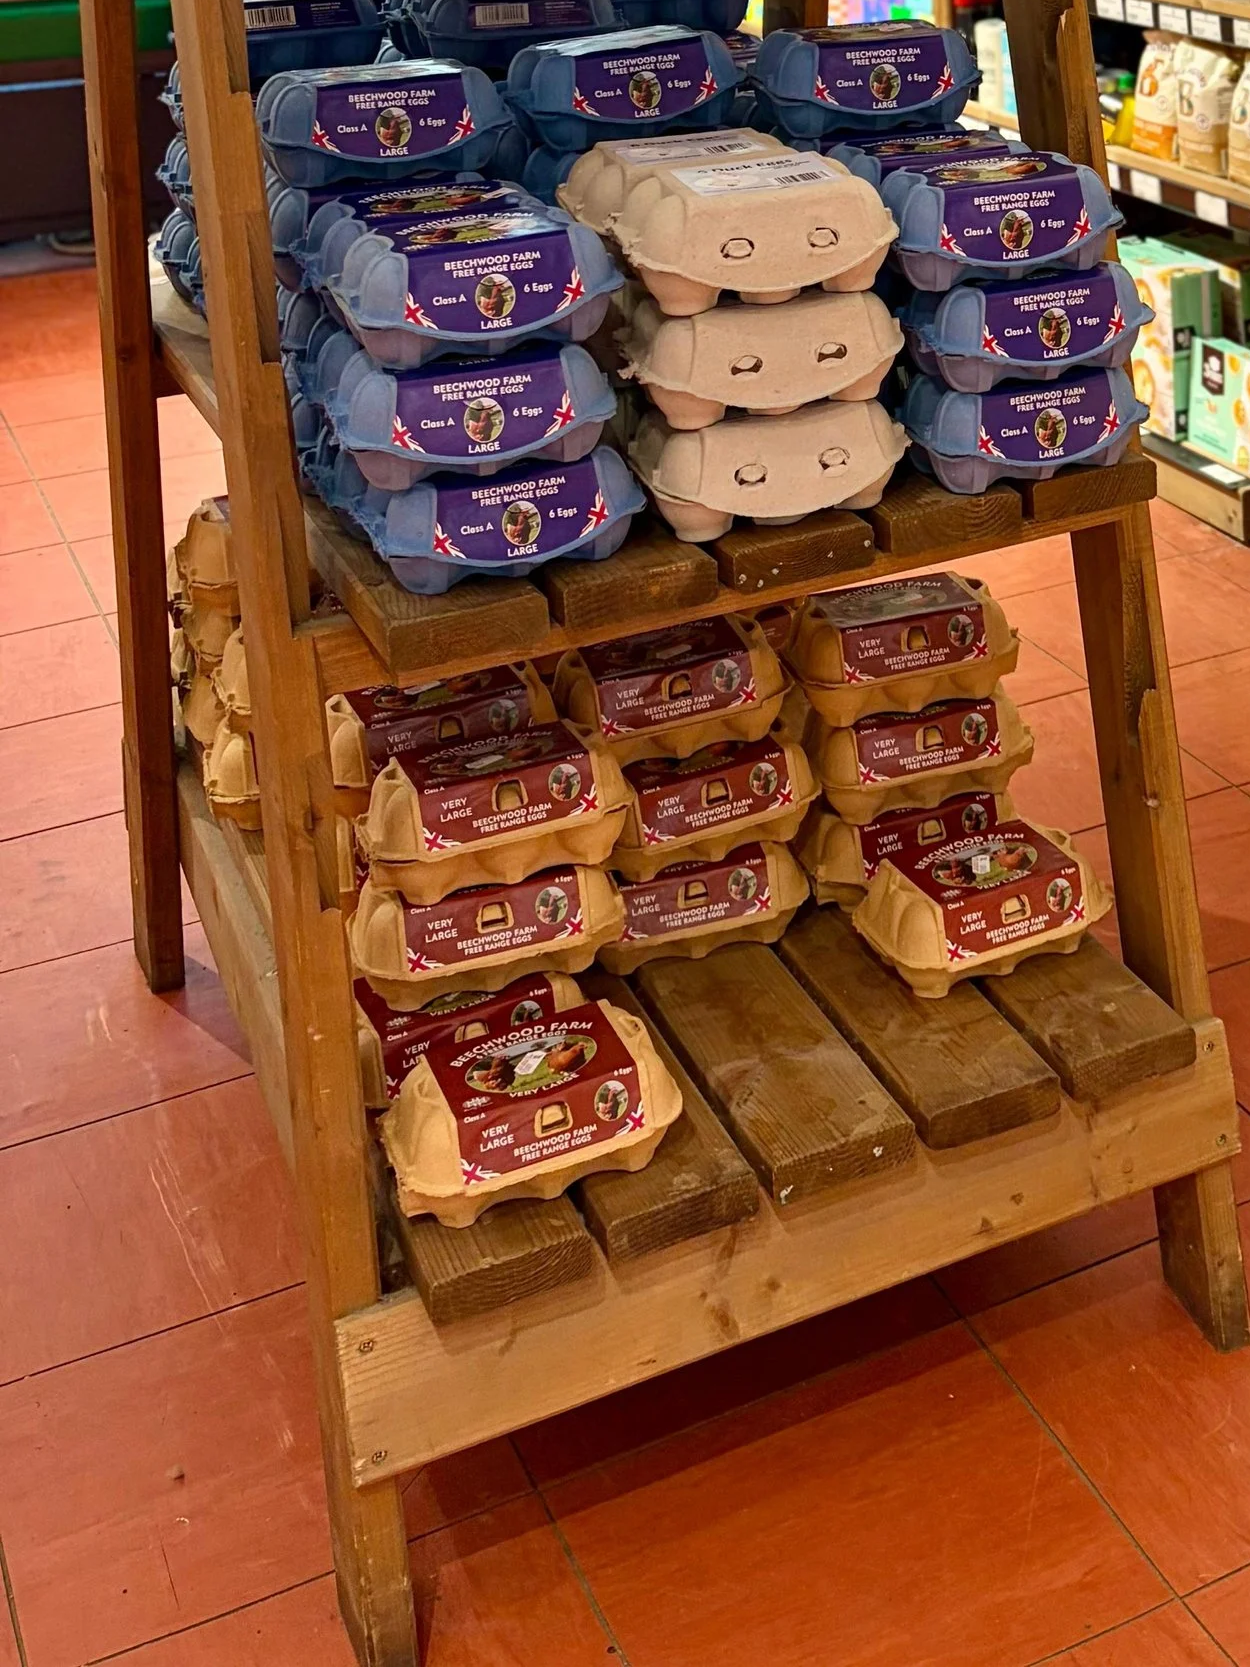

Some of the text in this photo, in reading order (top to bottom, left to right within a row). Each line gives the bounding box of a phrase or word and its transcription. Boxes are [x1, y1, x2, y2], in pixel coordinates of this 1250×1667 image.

[444, 251, 541, 271] BEECHWOOD FARM
[453, 260, 534, 279] FREE RANGE EGGS
[523, 282, 554, 293] 6 Eggs
[432, 294, 467, 306] Class A
[480, 317, 513, 330] LARGE
[450, 1021, 593, 1068] BEECHWOOD FARM
[509, 1073, 580, 1098] VERY LARGE
[482, 1124, 509, 1138] VERY
[513, 1124, 597, 1157] BEECHWOOD FARM
[480, 1134, 514, 1152] LARGE
[521, 1134, 592, 1163] FREE RANGE EGGS
